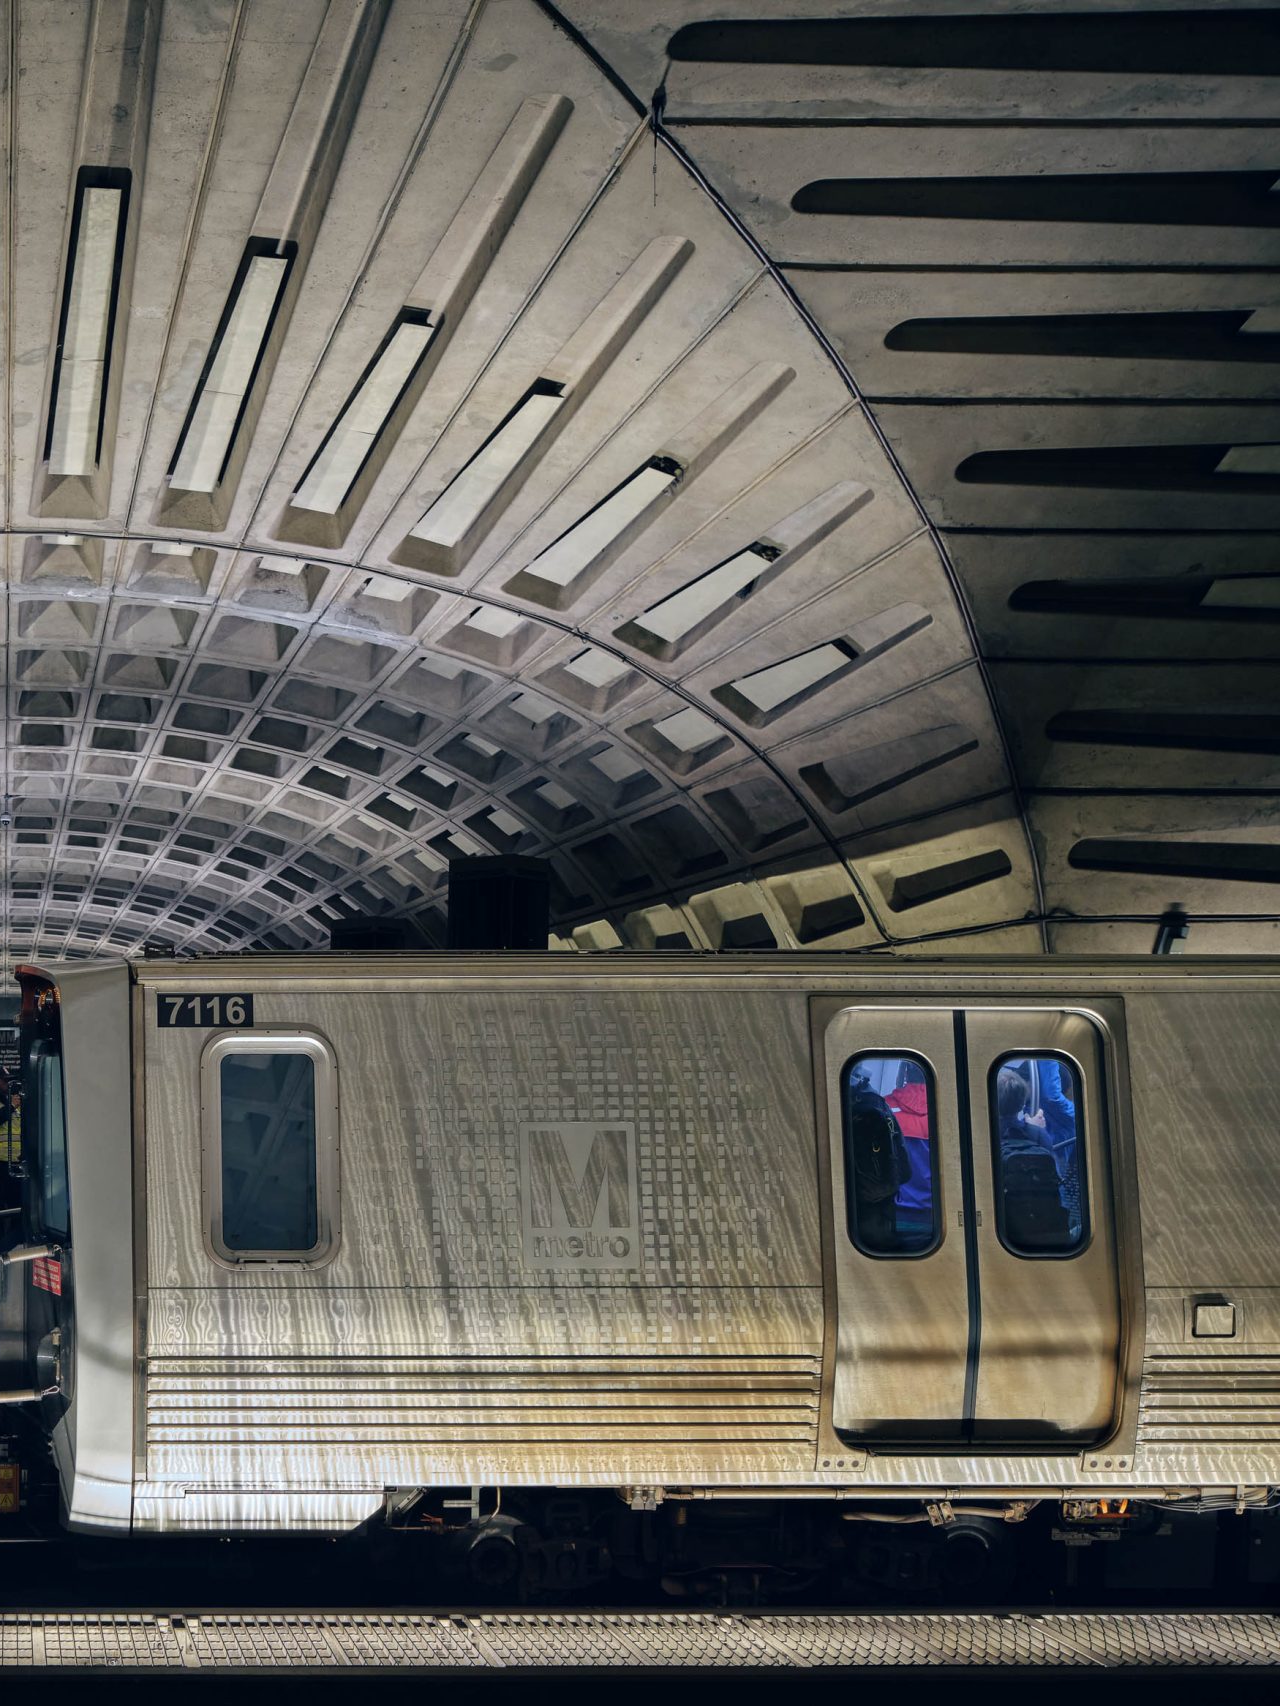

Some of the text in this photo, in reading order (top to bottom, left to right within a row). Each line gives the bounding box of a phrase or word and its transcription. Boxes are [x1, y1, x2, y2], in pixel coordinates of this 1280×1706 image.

[165, 996, 246, 1025] 7116
[529, 1130, 630, 1228] M
[533, 1231, 630, 1258] metro
